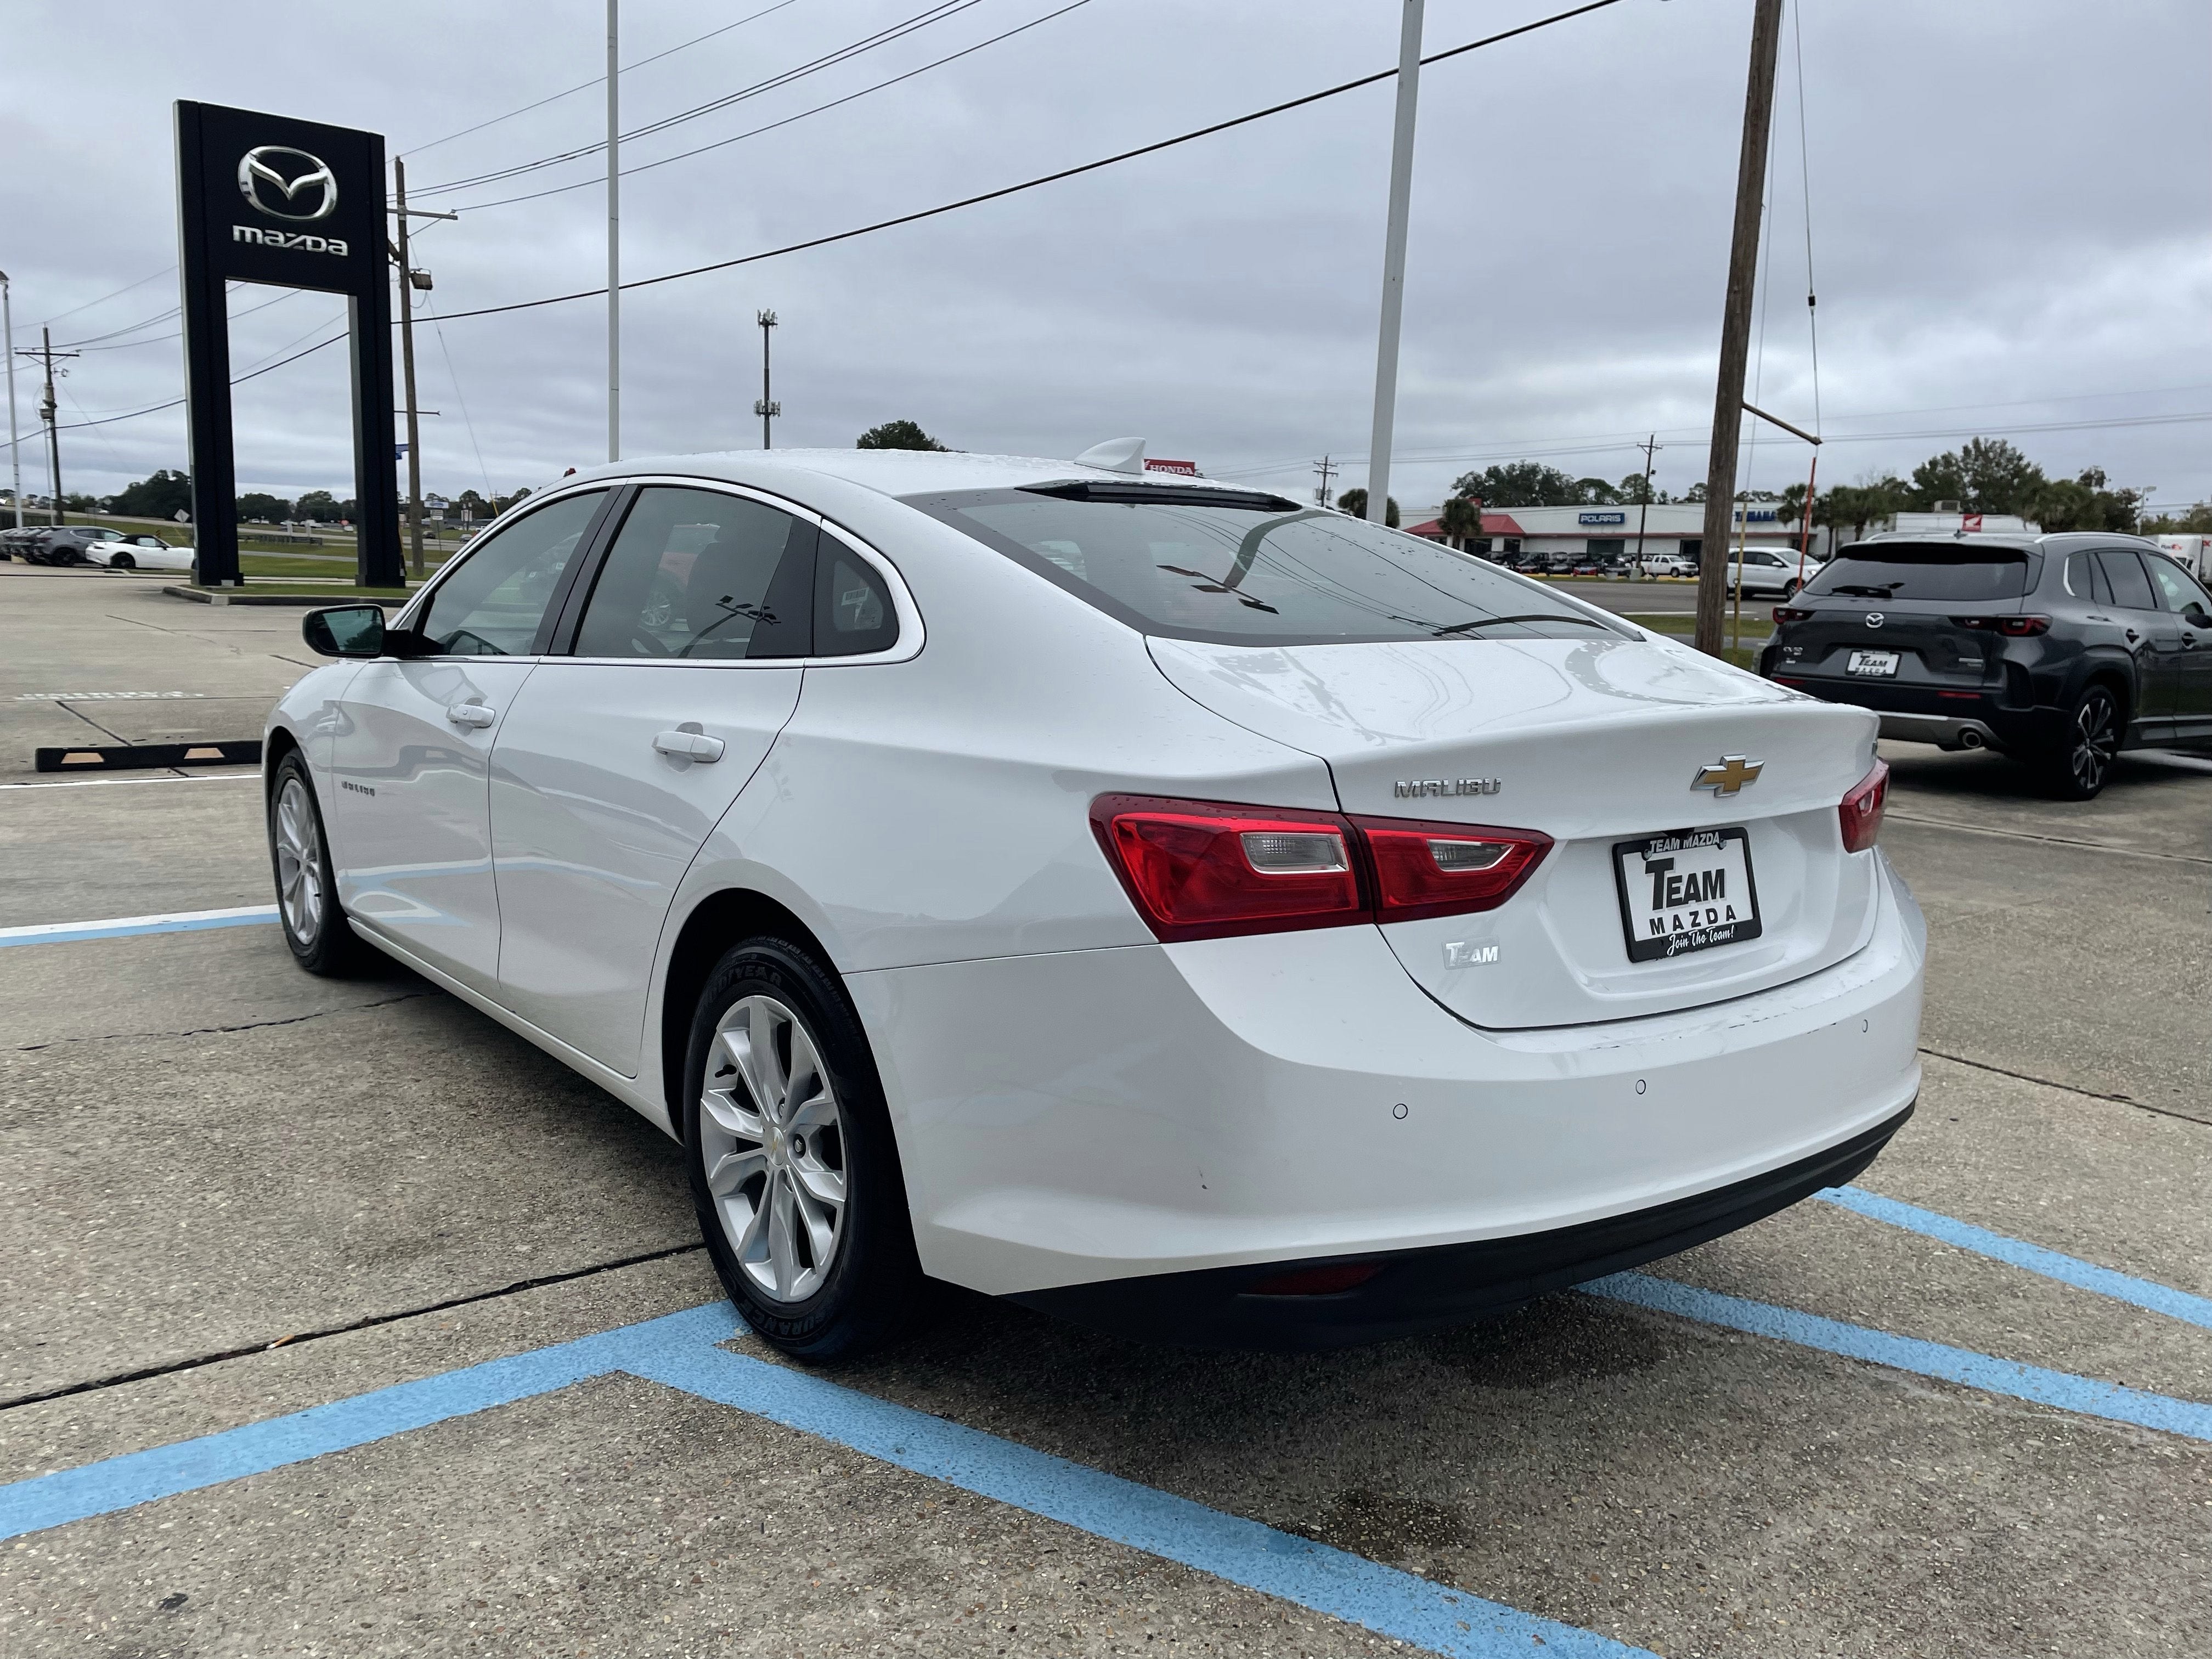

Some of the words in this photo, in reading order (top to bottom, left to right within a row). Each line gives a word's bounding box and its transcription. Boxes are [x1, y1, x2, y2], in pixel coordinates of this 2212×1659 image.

[1150, 465, 1194, 475] HONDA
[1580, 515, 1621, 523] POLARIS
[1858, 655, 1888, 667] TEAM
[1395, 777, 1501, 798] MALIBU
[1650, 838, 1680, 853] TEAM
[1683, 832, 1720, 848] MAZDA
[1645, 857, 1726, 912] TEAM
[1649, 905, 1736, 935] MAZDA
[1667, 934, 1690, 956] Join
[1689, 929, 1707, 947] The
[1706, 924, 1735, 945] Team!
